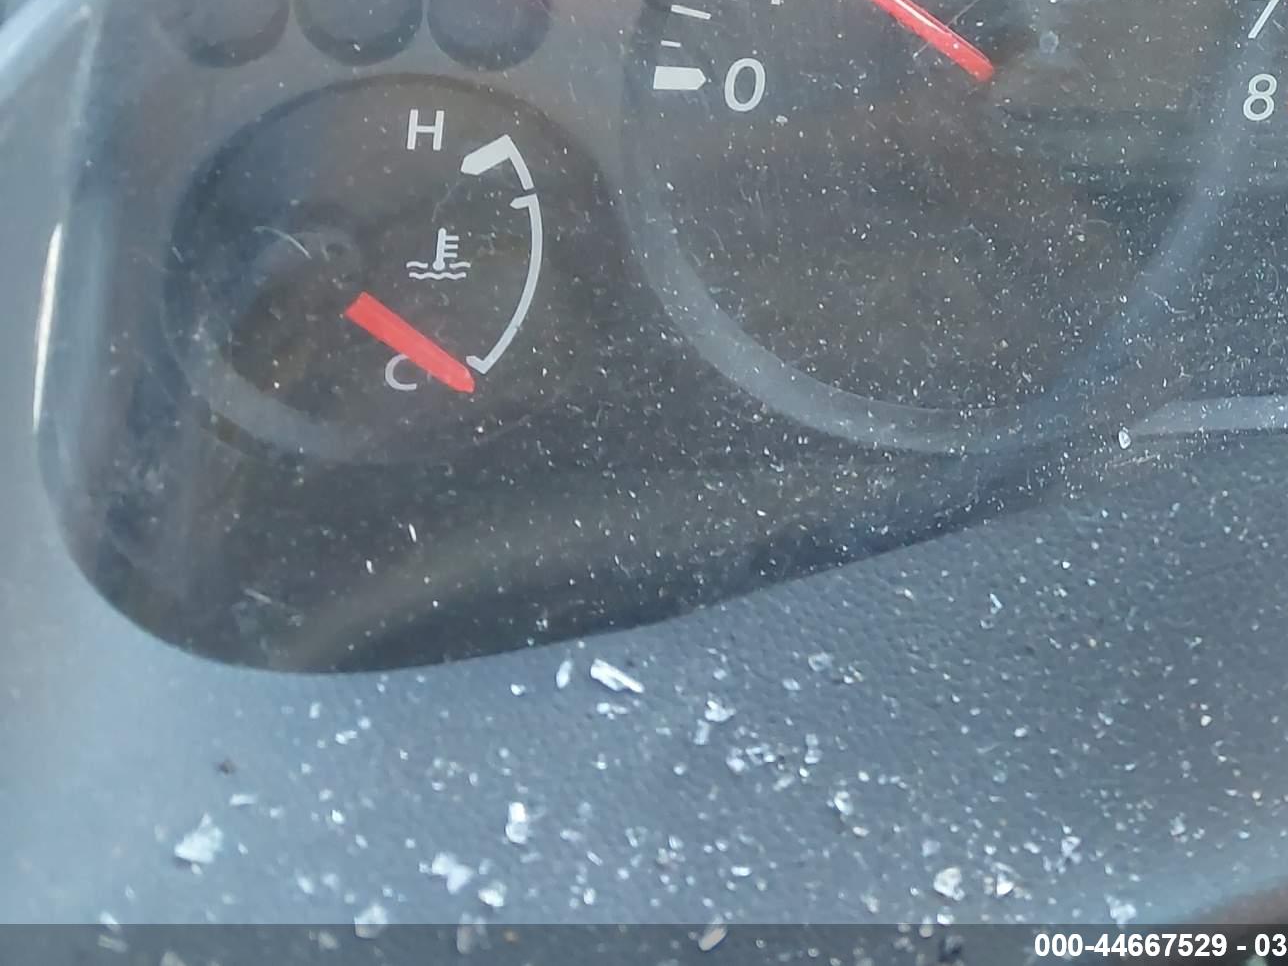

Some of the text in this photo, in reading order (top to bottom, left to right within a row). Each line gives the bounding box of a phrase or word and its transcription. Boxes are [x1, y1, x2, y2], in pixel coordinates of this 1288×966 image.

[723, 58, 766, 111] 0
[1242, 73, 1278, 121] 8
[406, 108, 444, 150] H
[384, 353, 418, 391] C
